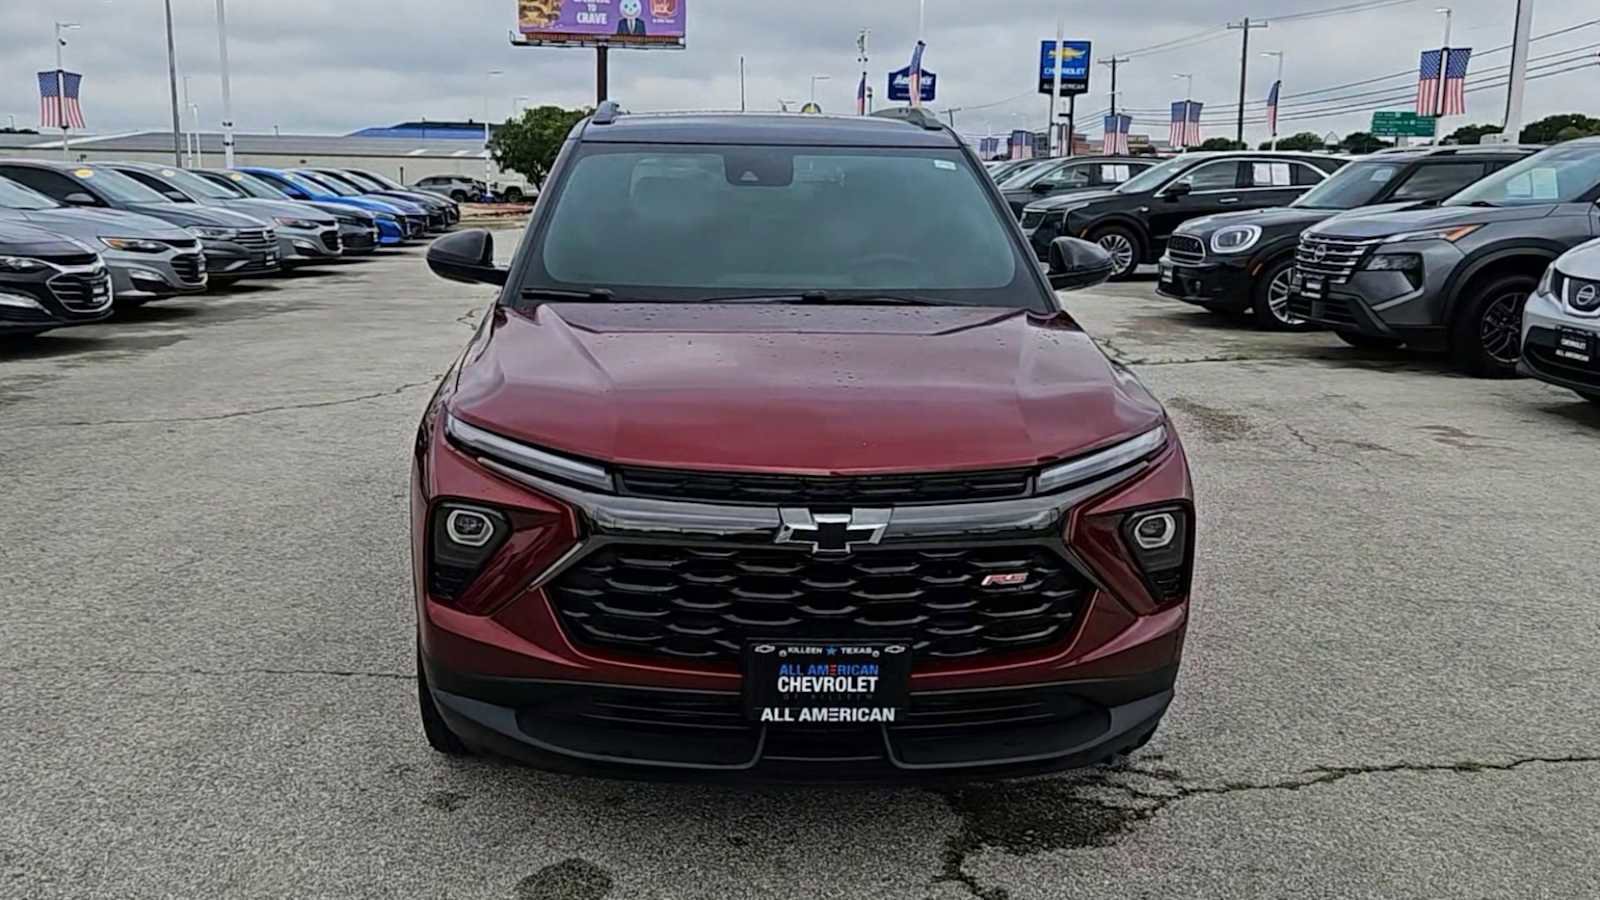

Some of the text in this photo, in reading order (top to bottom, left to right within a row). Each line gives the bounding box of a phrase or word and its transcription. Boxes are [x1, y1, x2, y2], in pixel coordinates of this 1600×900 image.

[587, 4, 598, 13] TO
[576, 13, 609, 25] CRAVE
[981, 572, 1029, 586] RS
[787, 647, 873, 655] KILLEEN TEXAS
[779, 664, 879, 676] ALL AMERICAN
[777, 676, 879, 693] CHEVROLET
[760, 707, 896, 722] ALL AMERICAN
